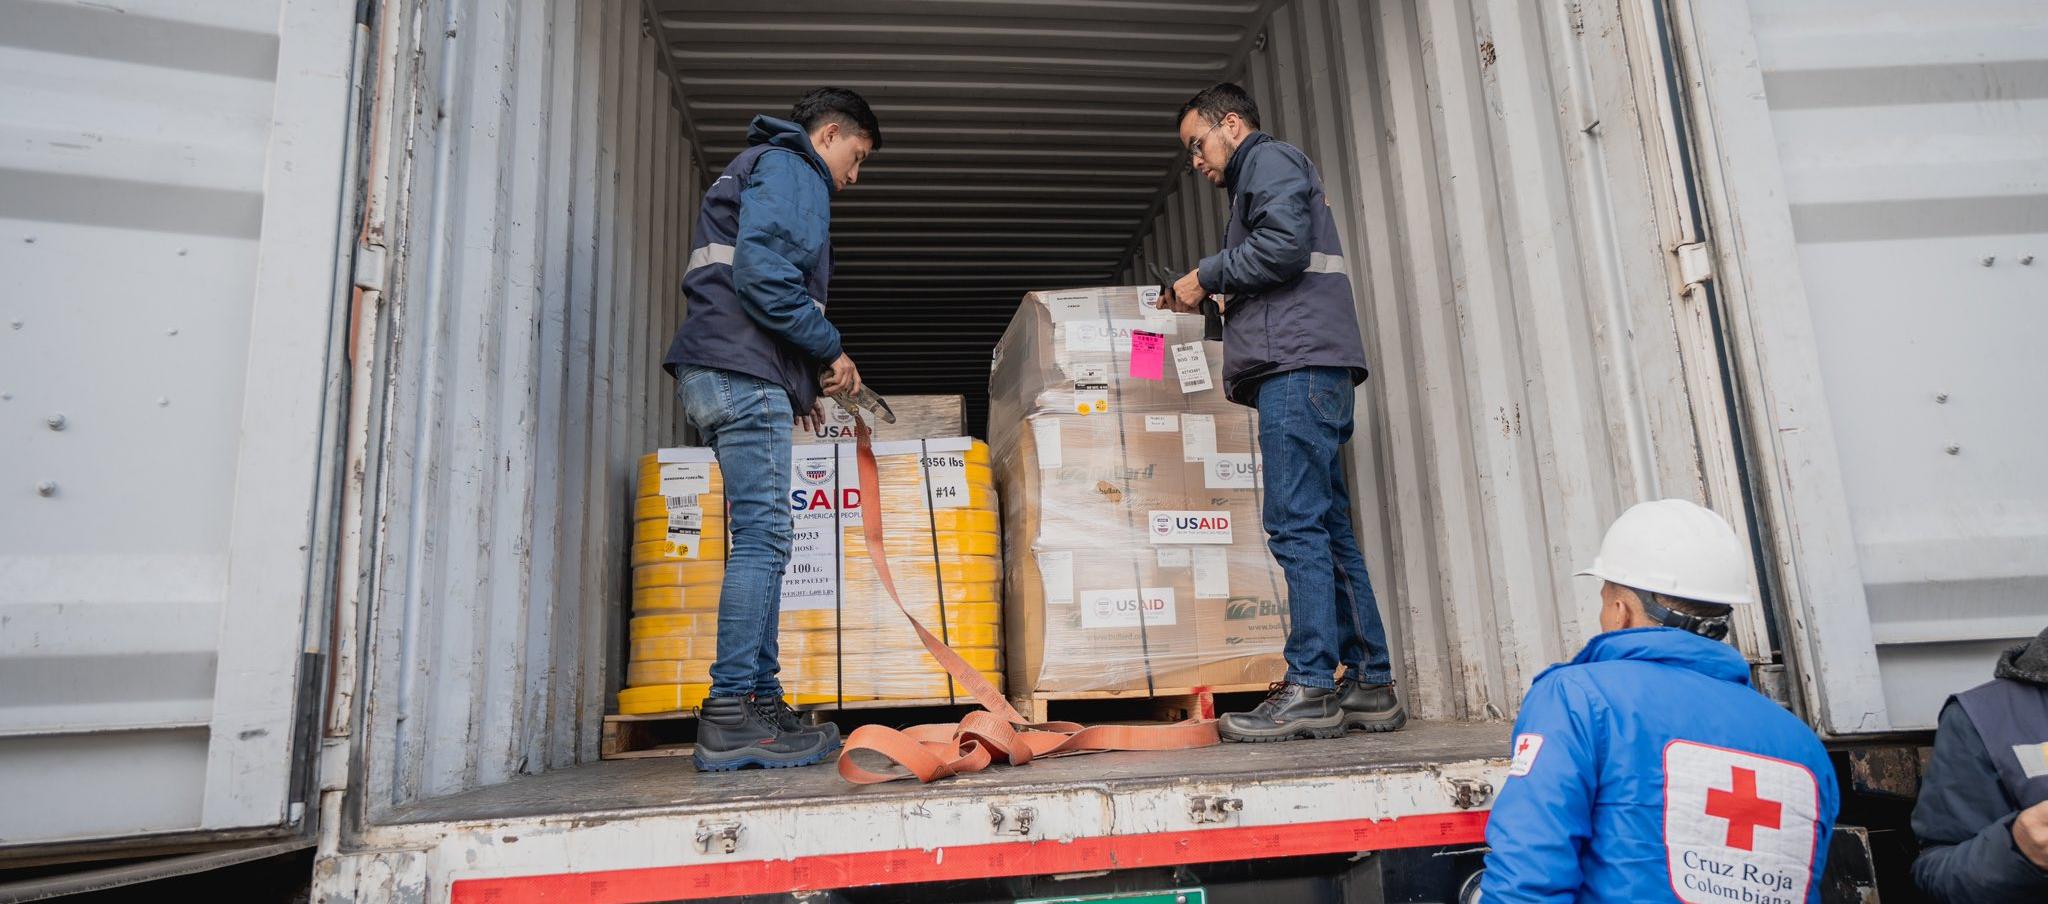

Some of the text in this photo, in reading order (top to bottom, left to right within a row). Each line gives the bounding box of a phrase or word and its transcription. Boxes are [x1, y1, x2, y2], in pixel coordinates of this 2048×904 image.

[1099, 328, 1132, 338] USA
[949, 457, 964, 467] lbs
[1236, 463, 1262, 474] USA
[935, 486, 956, 498] #14
[791, 488, 861, 511] SAID
[841, 510, 864, 519] PEOPL
[1176, 517, 1229, 530] USAID
[793, 563, 811, 574] 100
[1683, 850, 1793, 892] Cruz Roja
